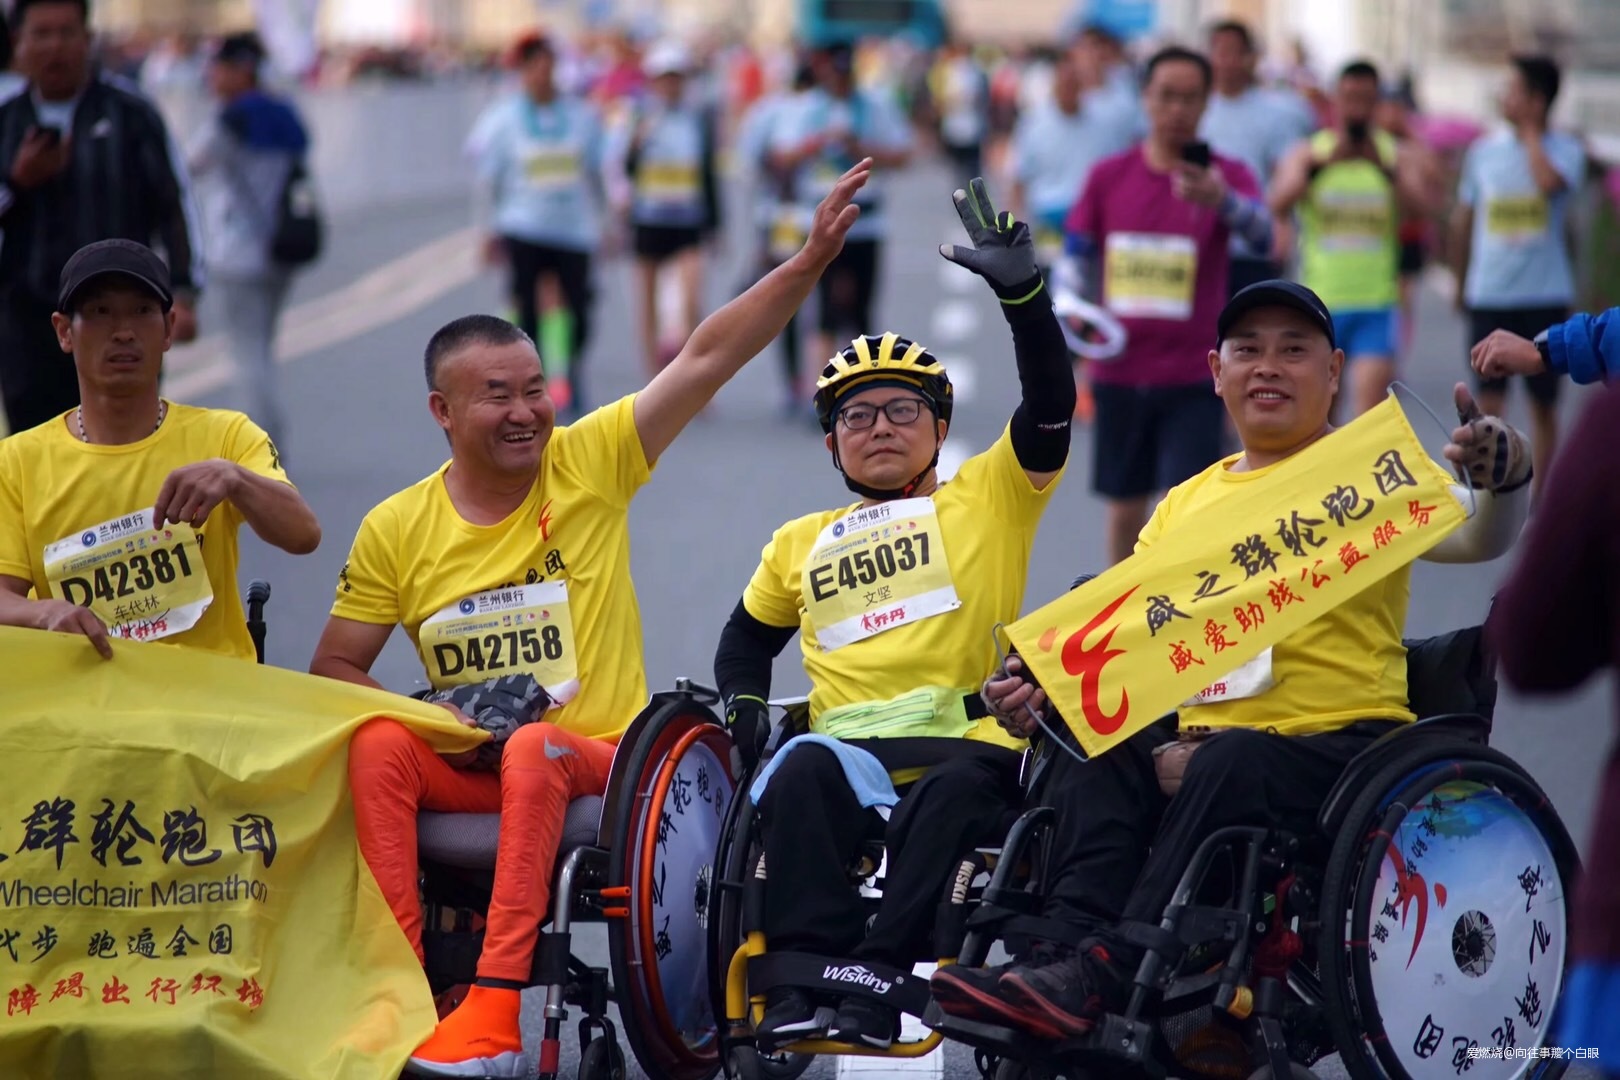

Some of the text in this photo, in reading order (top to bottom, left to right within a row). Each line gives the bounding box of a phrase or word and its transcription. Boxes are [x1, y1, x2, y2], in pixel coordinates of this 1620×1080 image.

[99, 513, 145, 538] 兰州银行
[848, 505, 891, 528] 兰州银行
[60, 542, 193, 608] D42381
[809, 531, 930, 603] E45037
[114, 594, 160, 619] 车代林
[479, 590, 525, 608] 兰州银行
[863, 585, 893, 607] 文坚
[432, 624, 563, 677] D42758
[151, 874, 269, 908] Marathon
[822, 965, 893, 995] Wisking
